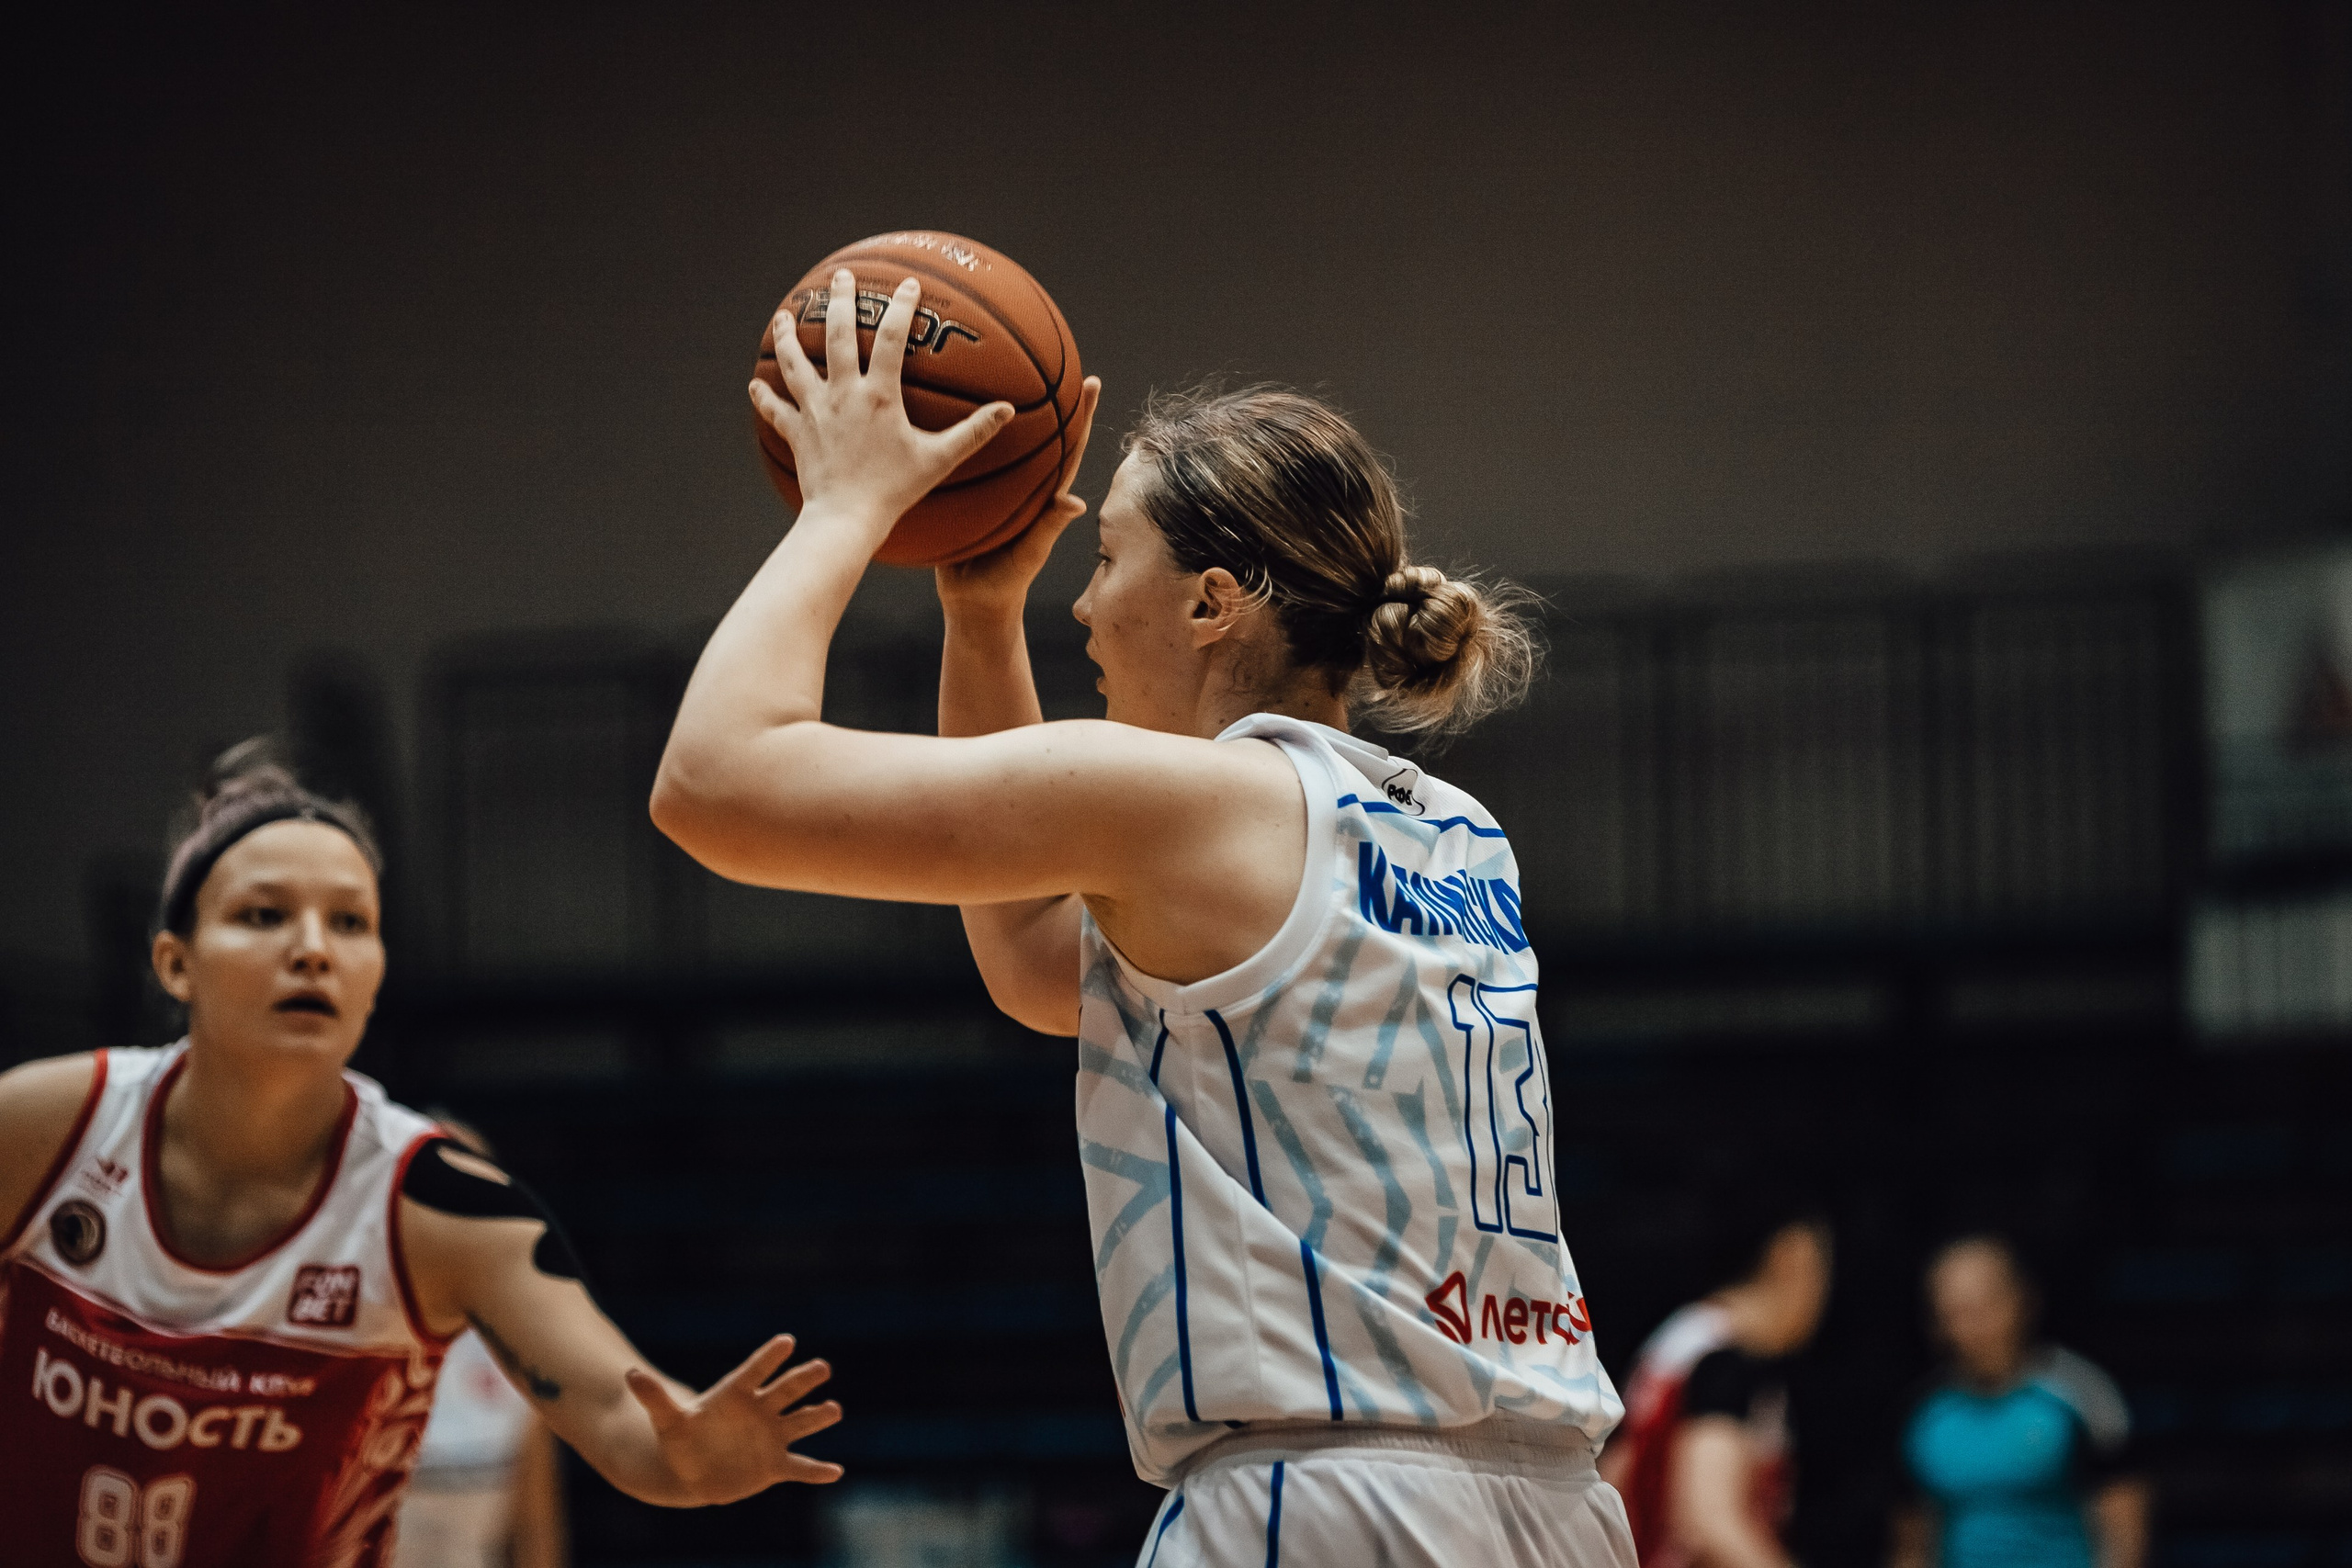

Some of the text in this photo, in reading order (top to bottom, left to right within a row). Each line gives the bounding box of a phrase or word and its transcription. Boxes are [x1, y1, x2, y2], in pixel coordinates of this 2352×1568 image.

[1447, 973, 1559, 1245] 13
[31, 1347, 304, 1452] ЮНОСТЬ
[75, 1464, 198, 1568] 88
